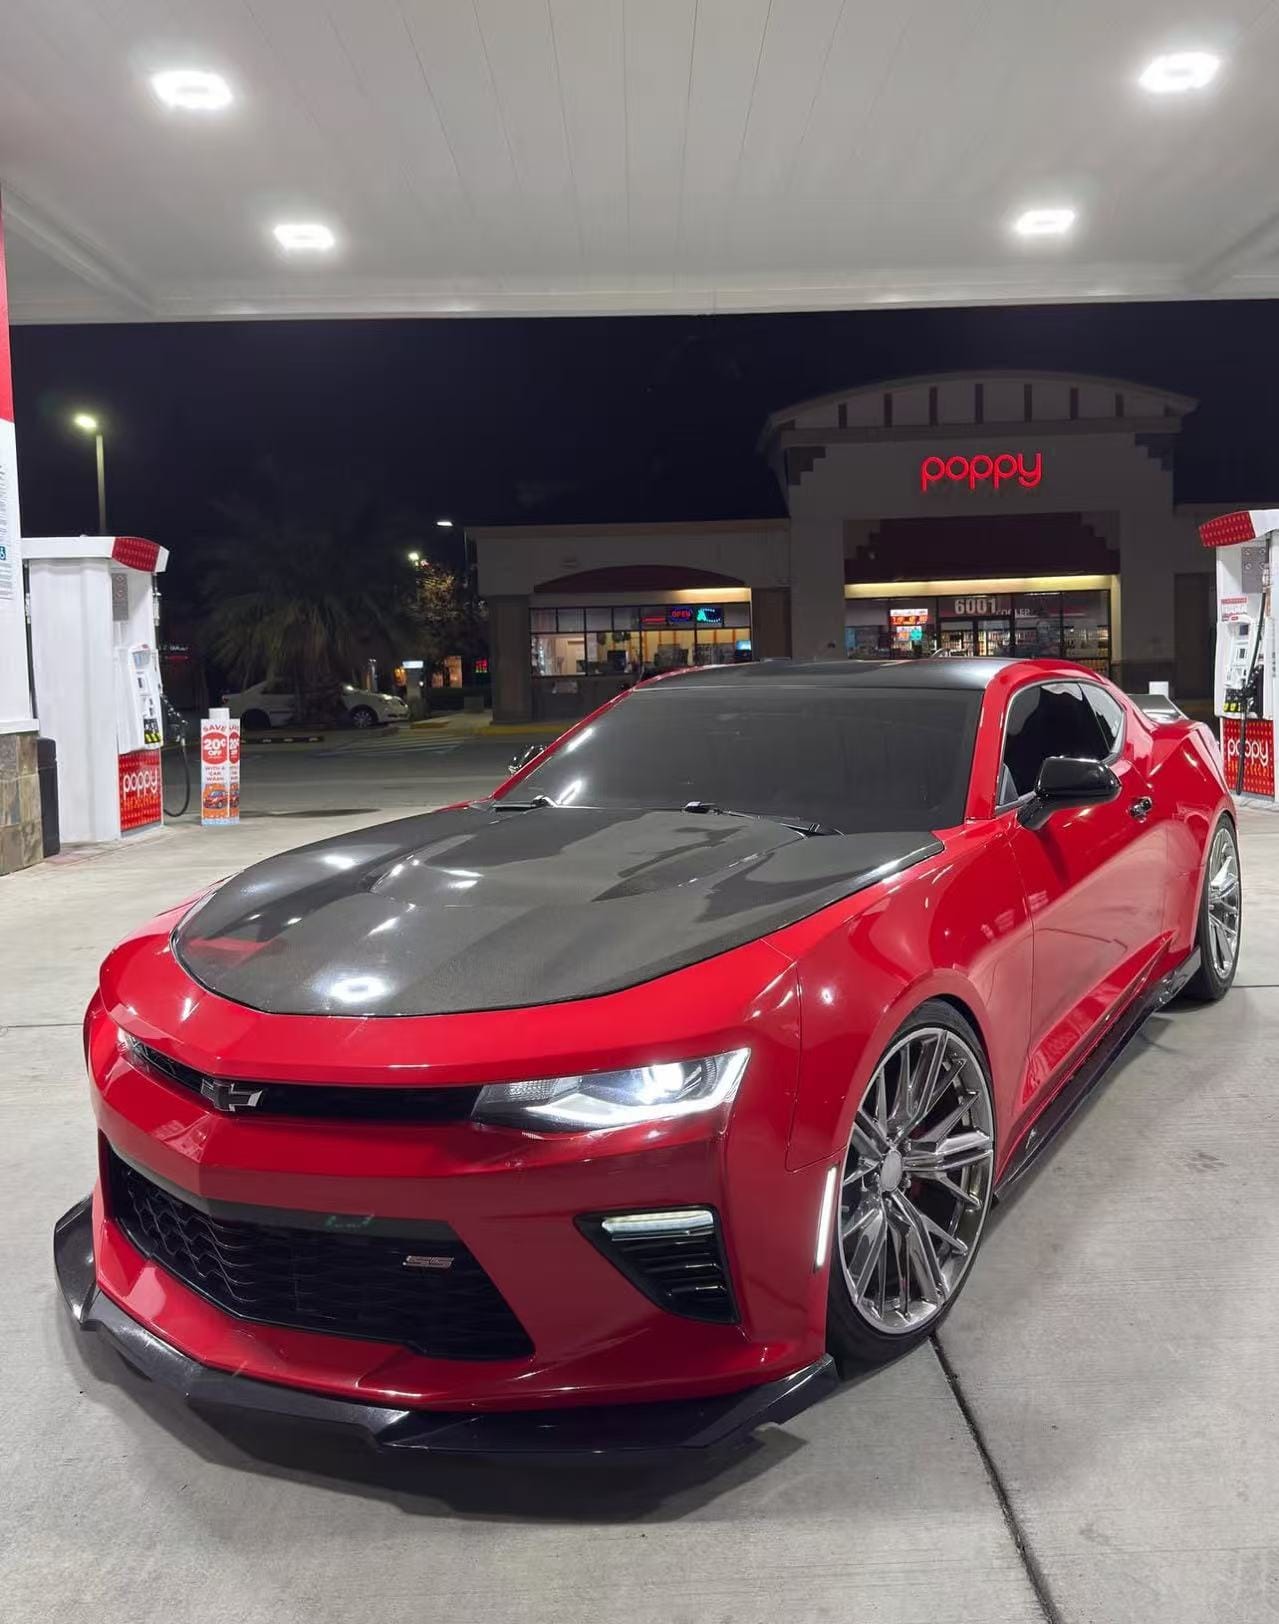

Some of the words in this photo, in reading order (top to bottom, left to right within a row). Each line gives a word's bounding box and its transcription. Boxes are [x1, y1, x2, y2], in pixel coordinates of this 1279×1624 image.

[921, 452, 1042, 491] poppy
[954, 598, 996, 615] 6001
[203, 724, 226, 732] SAVE
[123, 768, 158, 801] poppy
